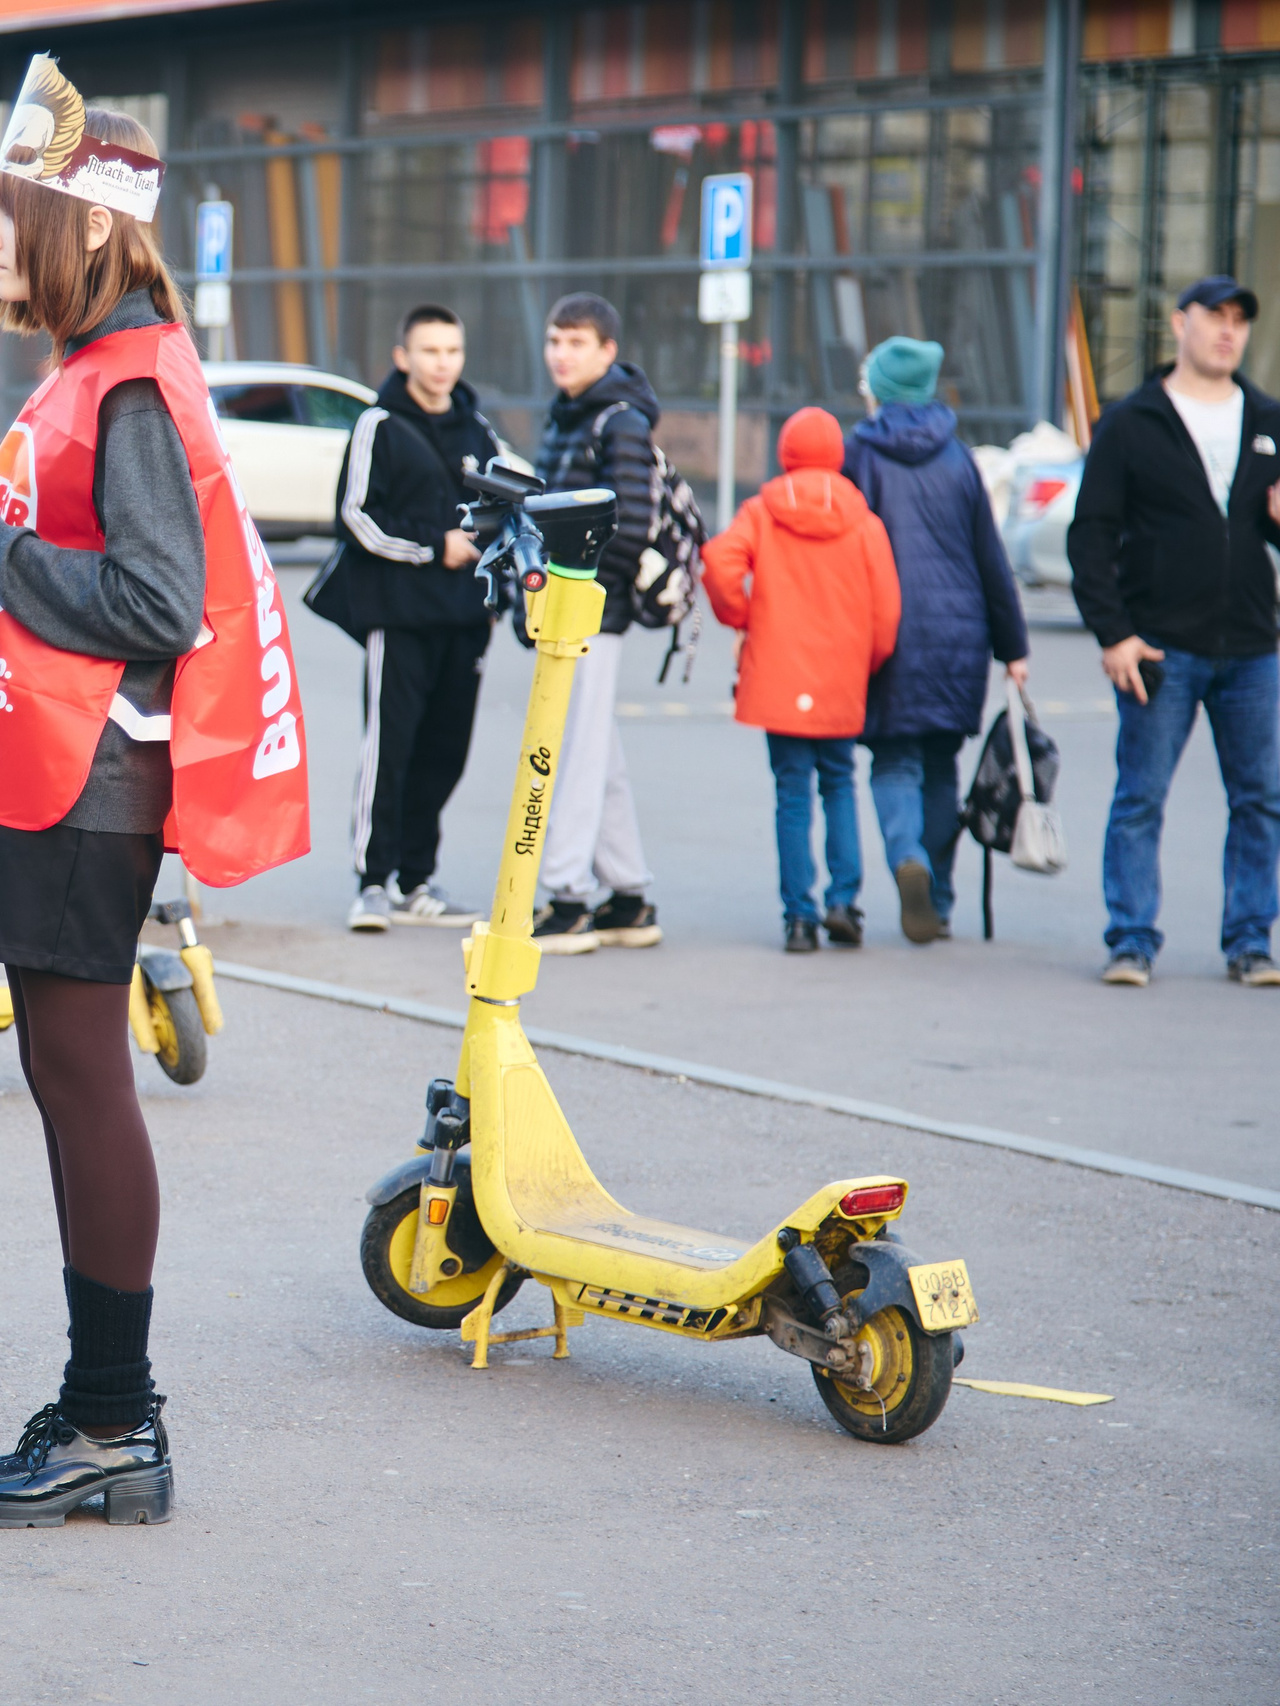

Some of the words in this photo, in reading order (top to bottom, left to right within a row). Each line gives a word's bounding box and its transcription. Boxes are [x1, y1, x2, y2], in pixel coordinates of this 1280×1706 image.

[87, 155, 124, 183] Attack
[125, 174, 134, 183] on
[135, 172, 154, 192] Titan
[203, 213, 228, 274] P
[711, 186, 743, 260] P
[529, 746, 551, 776] Go
